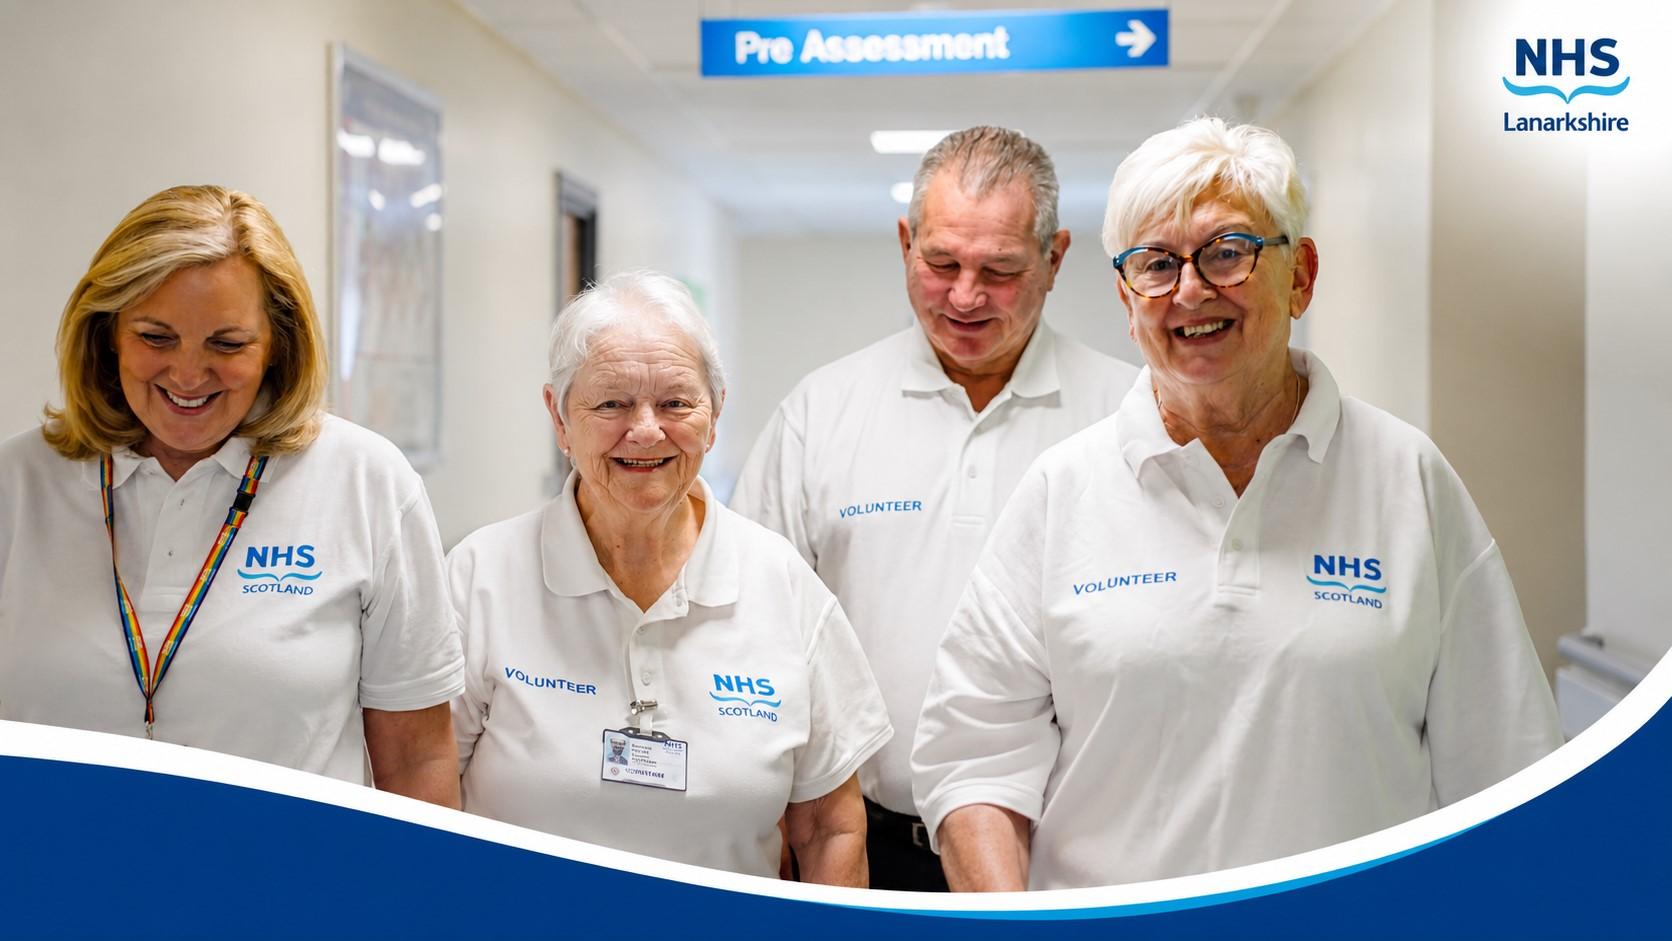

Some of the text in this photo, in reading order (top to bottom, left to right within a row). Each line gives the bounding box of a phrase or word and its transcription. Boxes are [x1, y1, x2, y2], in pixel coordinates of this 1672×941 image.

[735, 26, 1010, 64] Pre Assessment
[839, 500, 922, 519] VOLUNTEER
[245, 545, 315, 568] NHS
[1314, 554, 1382, 581] NHS
[242, 583, 314, 596] SCOTLAND
[1073, 571, 1177, 595] VOLUNTEER
[1314, 591, 1383, 609] SCOTLAND
[505, 667, 597, 695] VOLUNTEER
[713, 674, 775, 696] NHS
[718, 707, 778, 722] SCOTLAND
